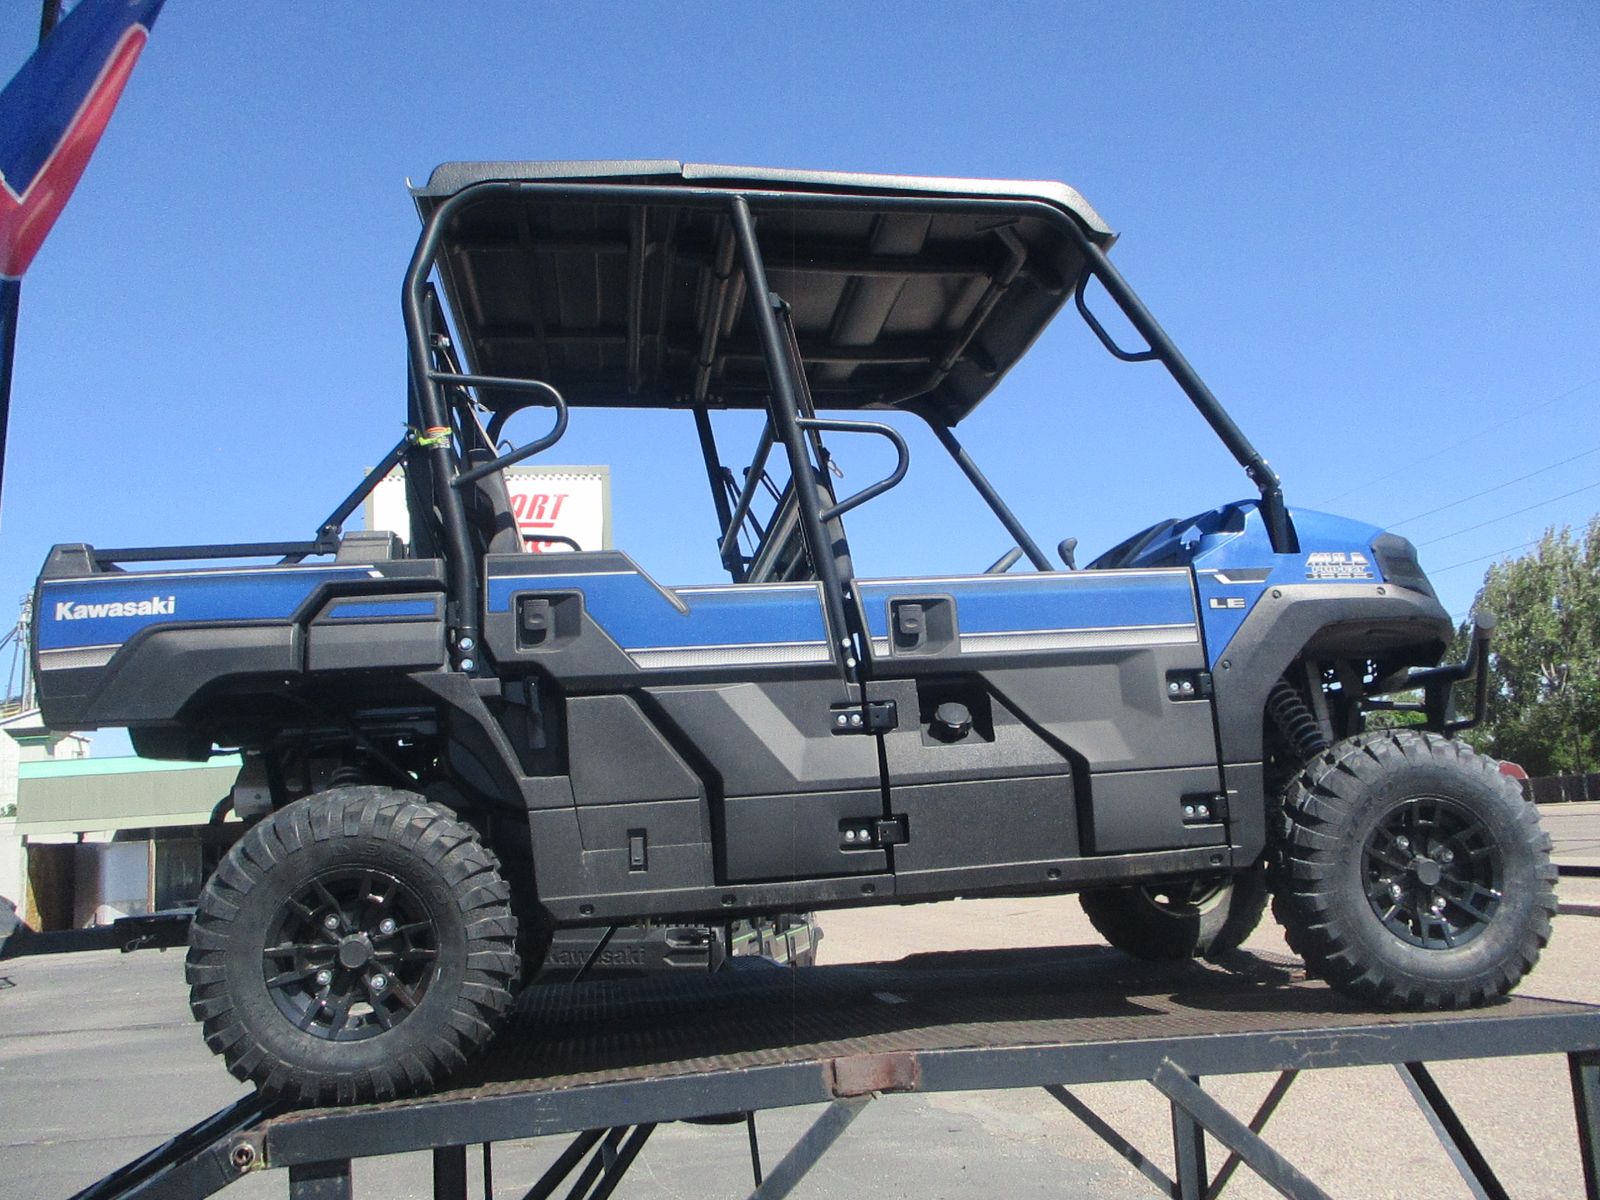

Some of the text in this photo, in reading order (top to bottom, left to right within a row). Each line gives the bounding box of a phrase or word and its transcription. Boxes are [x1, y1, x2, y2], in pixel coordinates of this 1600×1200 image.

[55, 596, 176, 621] Kawasaki
[1209, 598, 1246, 609] LE
[544, 946, 646, 966] Kawsaki
